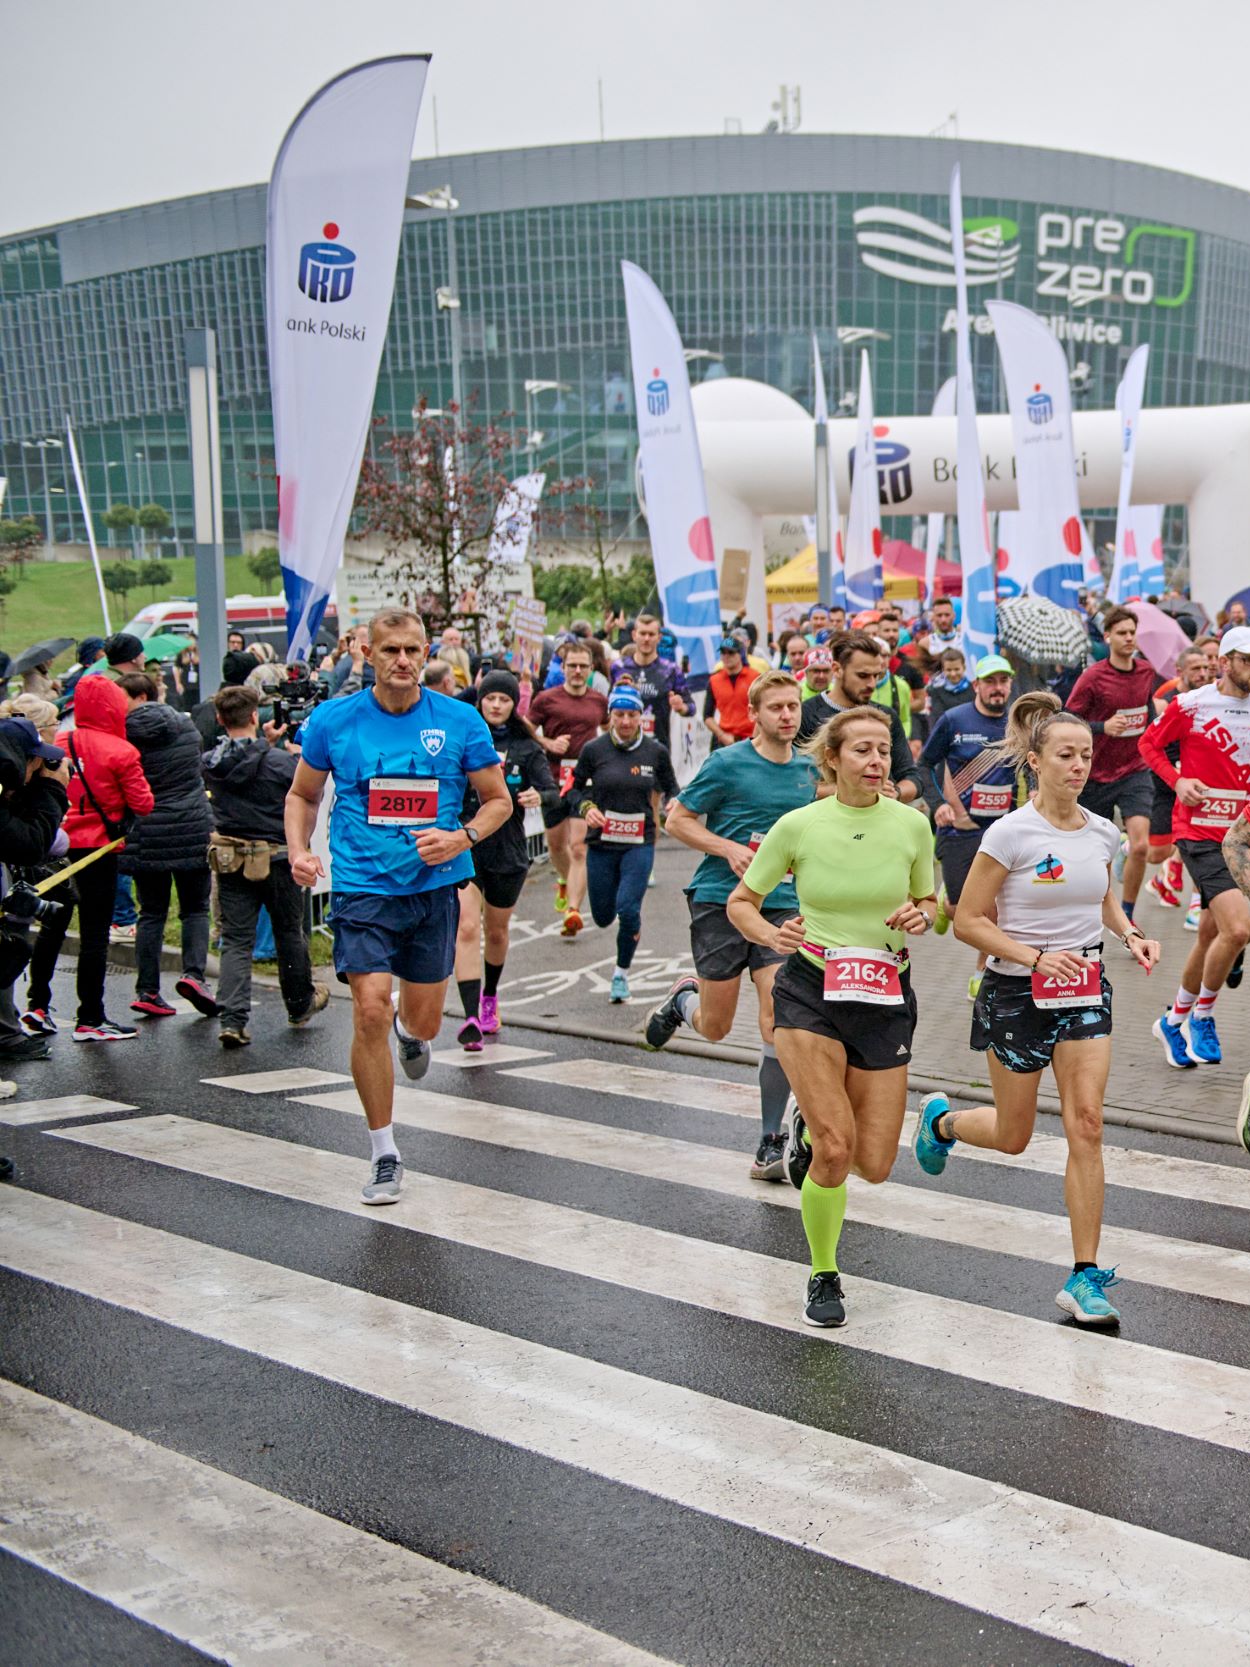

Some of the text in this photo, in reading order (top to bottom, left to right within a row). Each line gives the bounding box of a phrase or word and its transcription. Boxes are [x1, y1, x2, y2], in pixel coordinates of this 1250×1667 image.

[1038, 213, 1125, 256] pre
[1037, 262, 1153, 305] zero
[287, 318, 366, 341] ank Polski
[942, 308, 996, 335] Are
[933, 456, 1000, 482] Bak
[380, 796, 427, 812] 2817
[977, 793, 1008, 806] 2559
[1201, 799, 1237, 815] 2431
[608, 820, 640, 833] 2265
[836, 962, 889, 986] 2164
[840, 983, 886, 994] ALEKSANDRA
[1057, 990, 1076, 998] ANNA
